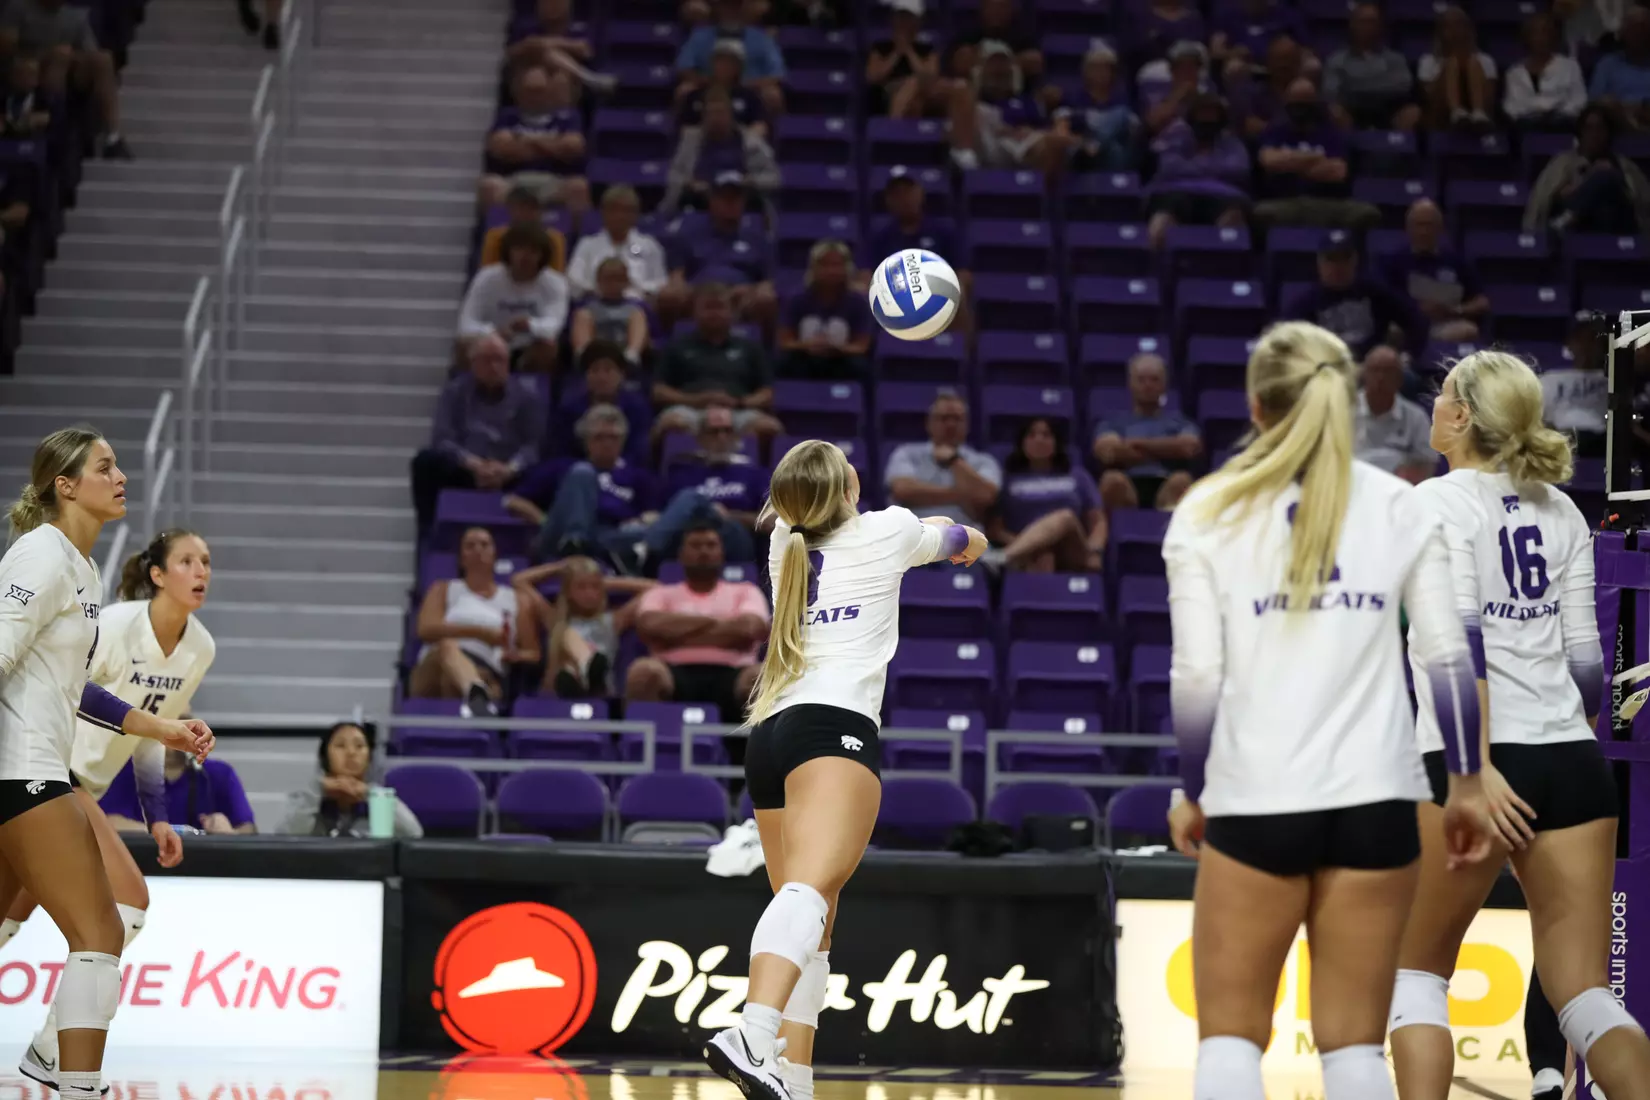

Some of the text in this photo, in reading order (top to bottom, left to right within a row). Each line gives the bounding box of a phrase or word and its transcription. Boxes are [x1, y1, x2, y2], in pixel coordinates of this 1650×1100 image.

[904, 253, 923, 294] molten
[1498, 525, 1551, 600] 16
[1483, 600, 1560, 621] WILDCAT
[130, 671, 185, 691] K-STATE
[1610, 891, 1628, 955] sports
[862, 949, 1050, 1034] Hut
